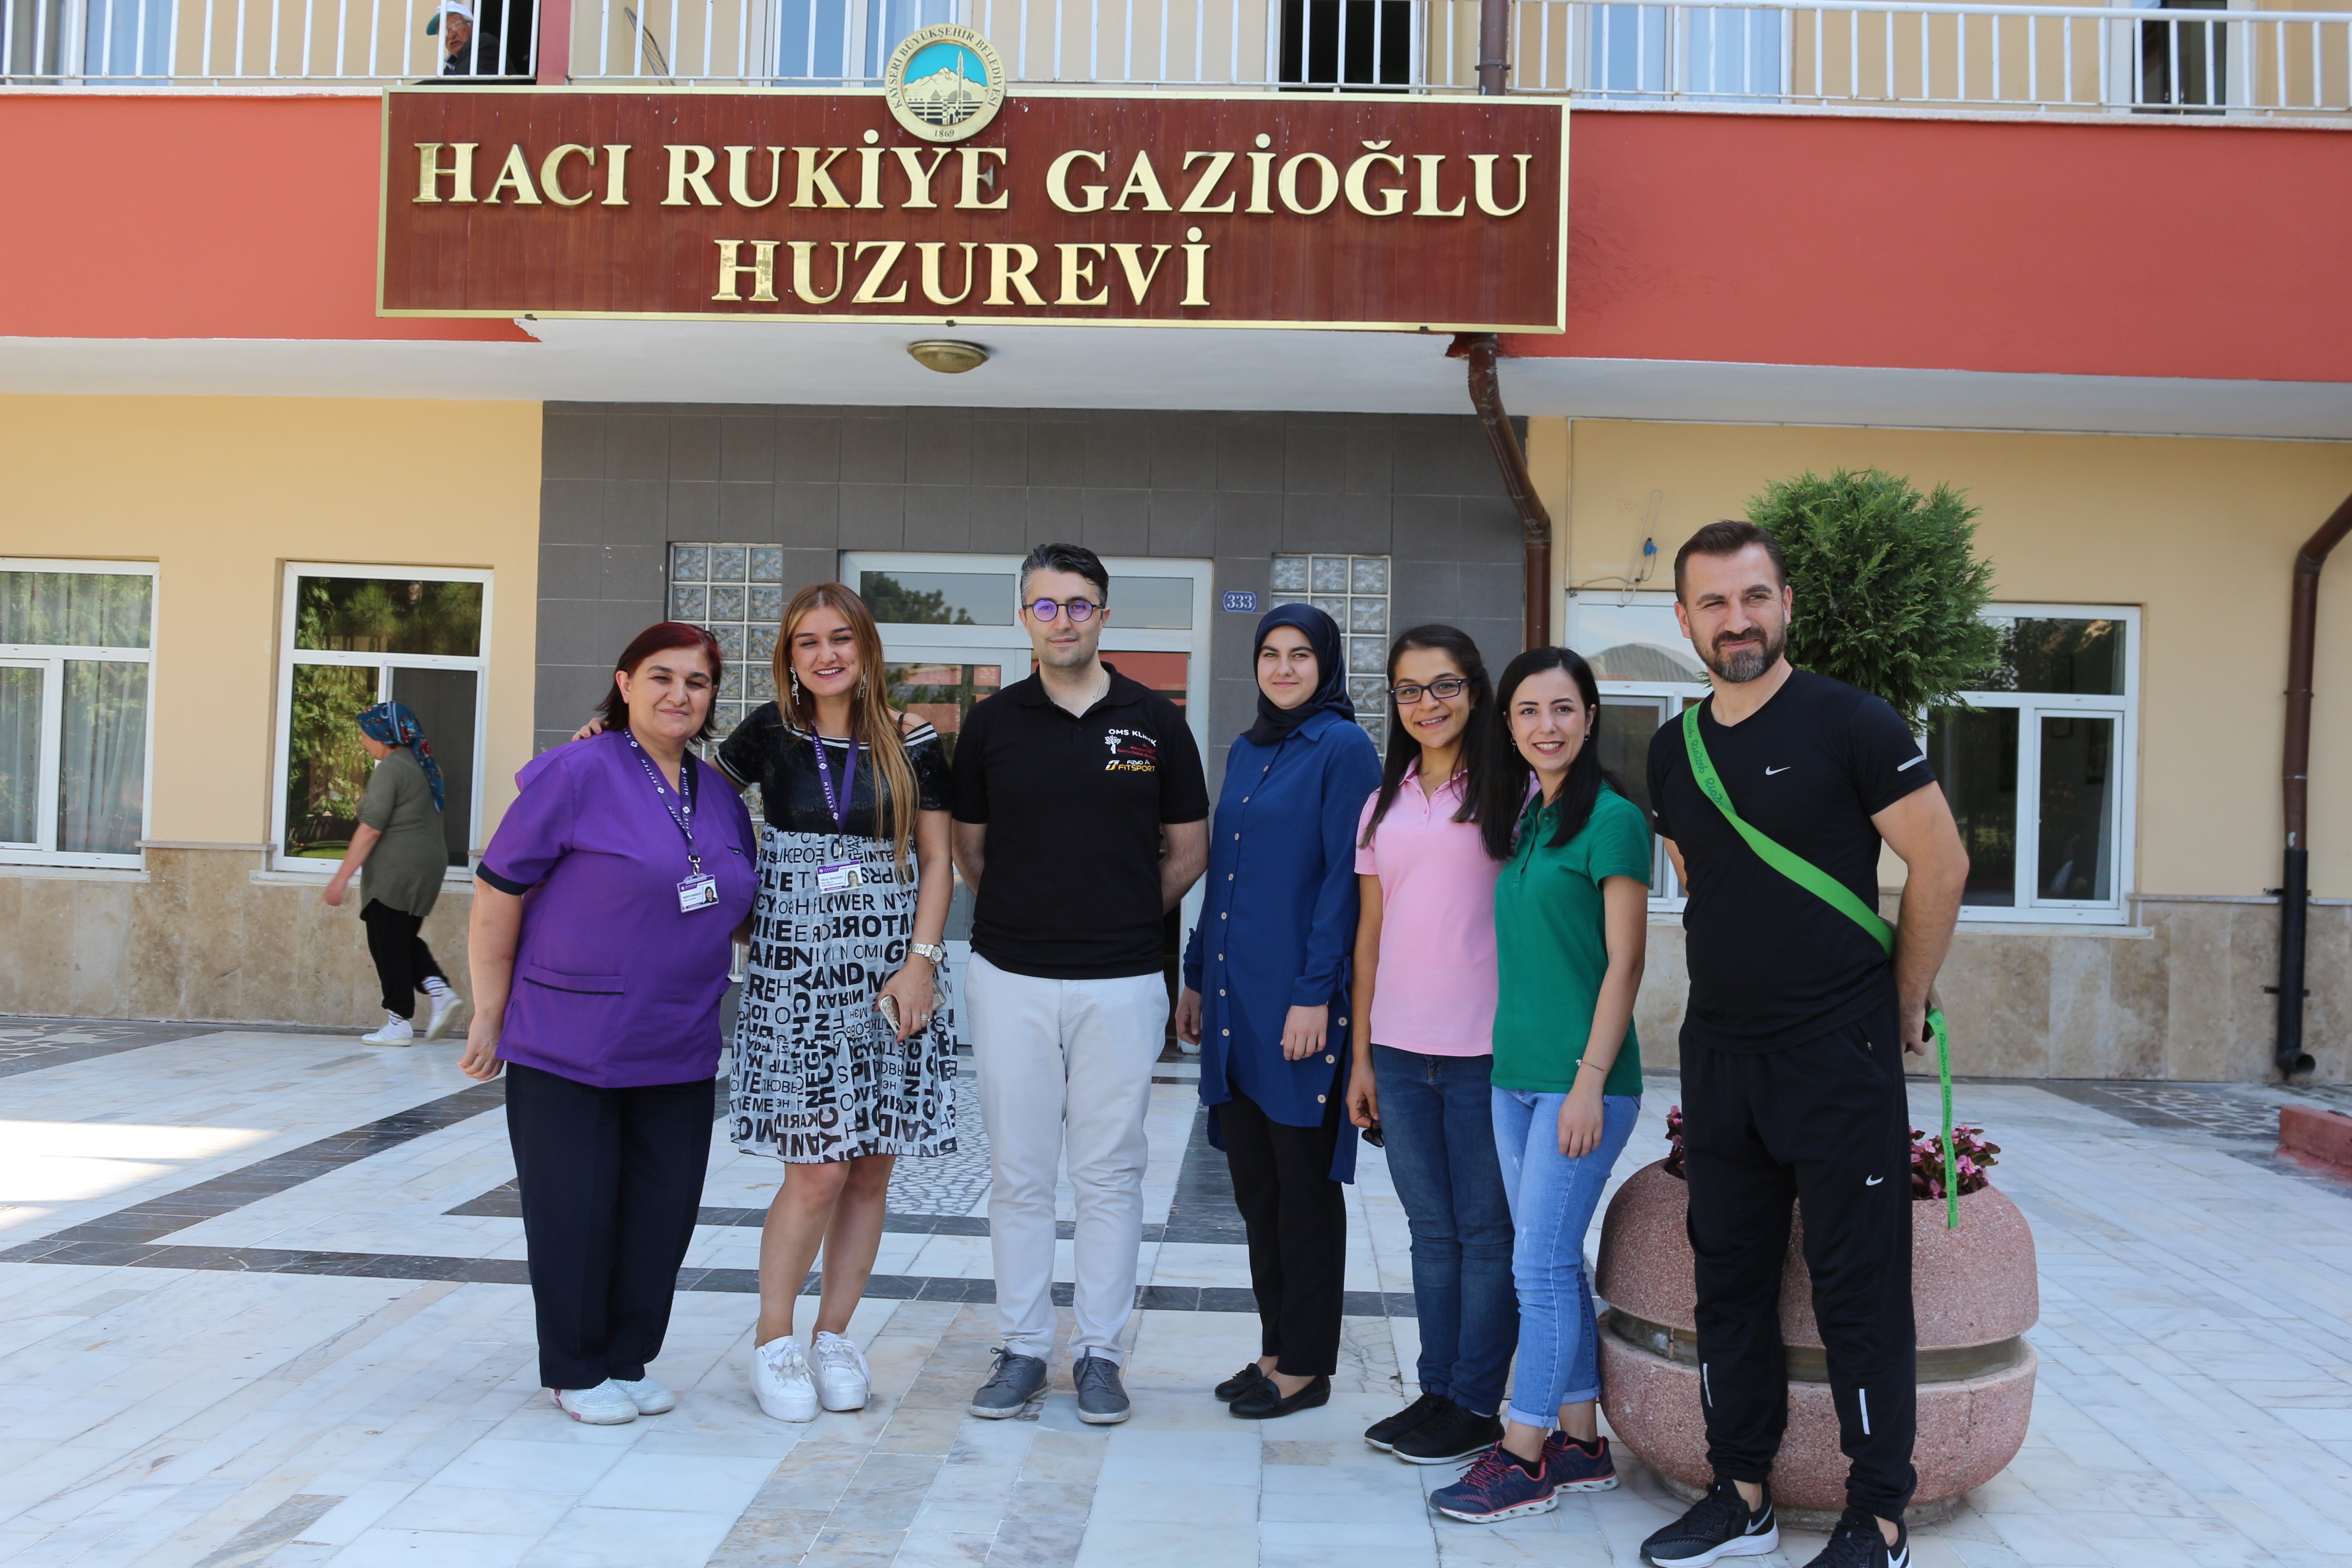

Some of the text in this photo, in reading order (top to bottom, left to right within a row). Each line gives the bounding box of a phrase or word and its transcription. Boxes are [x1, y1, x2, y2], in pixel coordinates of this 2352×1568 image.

[888, 27, 1004, 110] KAYSERİ BÜYÜKŞEHİR BELEDİYESİ
[934, 129, 955, 137] 1869
[412, 129, 1532, 217] HACI RUKİYE GAZİOĞLU
[711, 227, 1210, 306] HUZUREVİ
[1227, 594, 1252, 609] 333
[813, 736, 823, 760] SYSTEM
[641, 759, 658, 784] SYSTEM
[823, 782, 833, 808] SYSTEM
